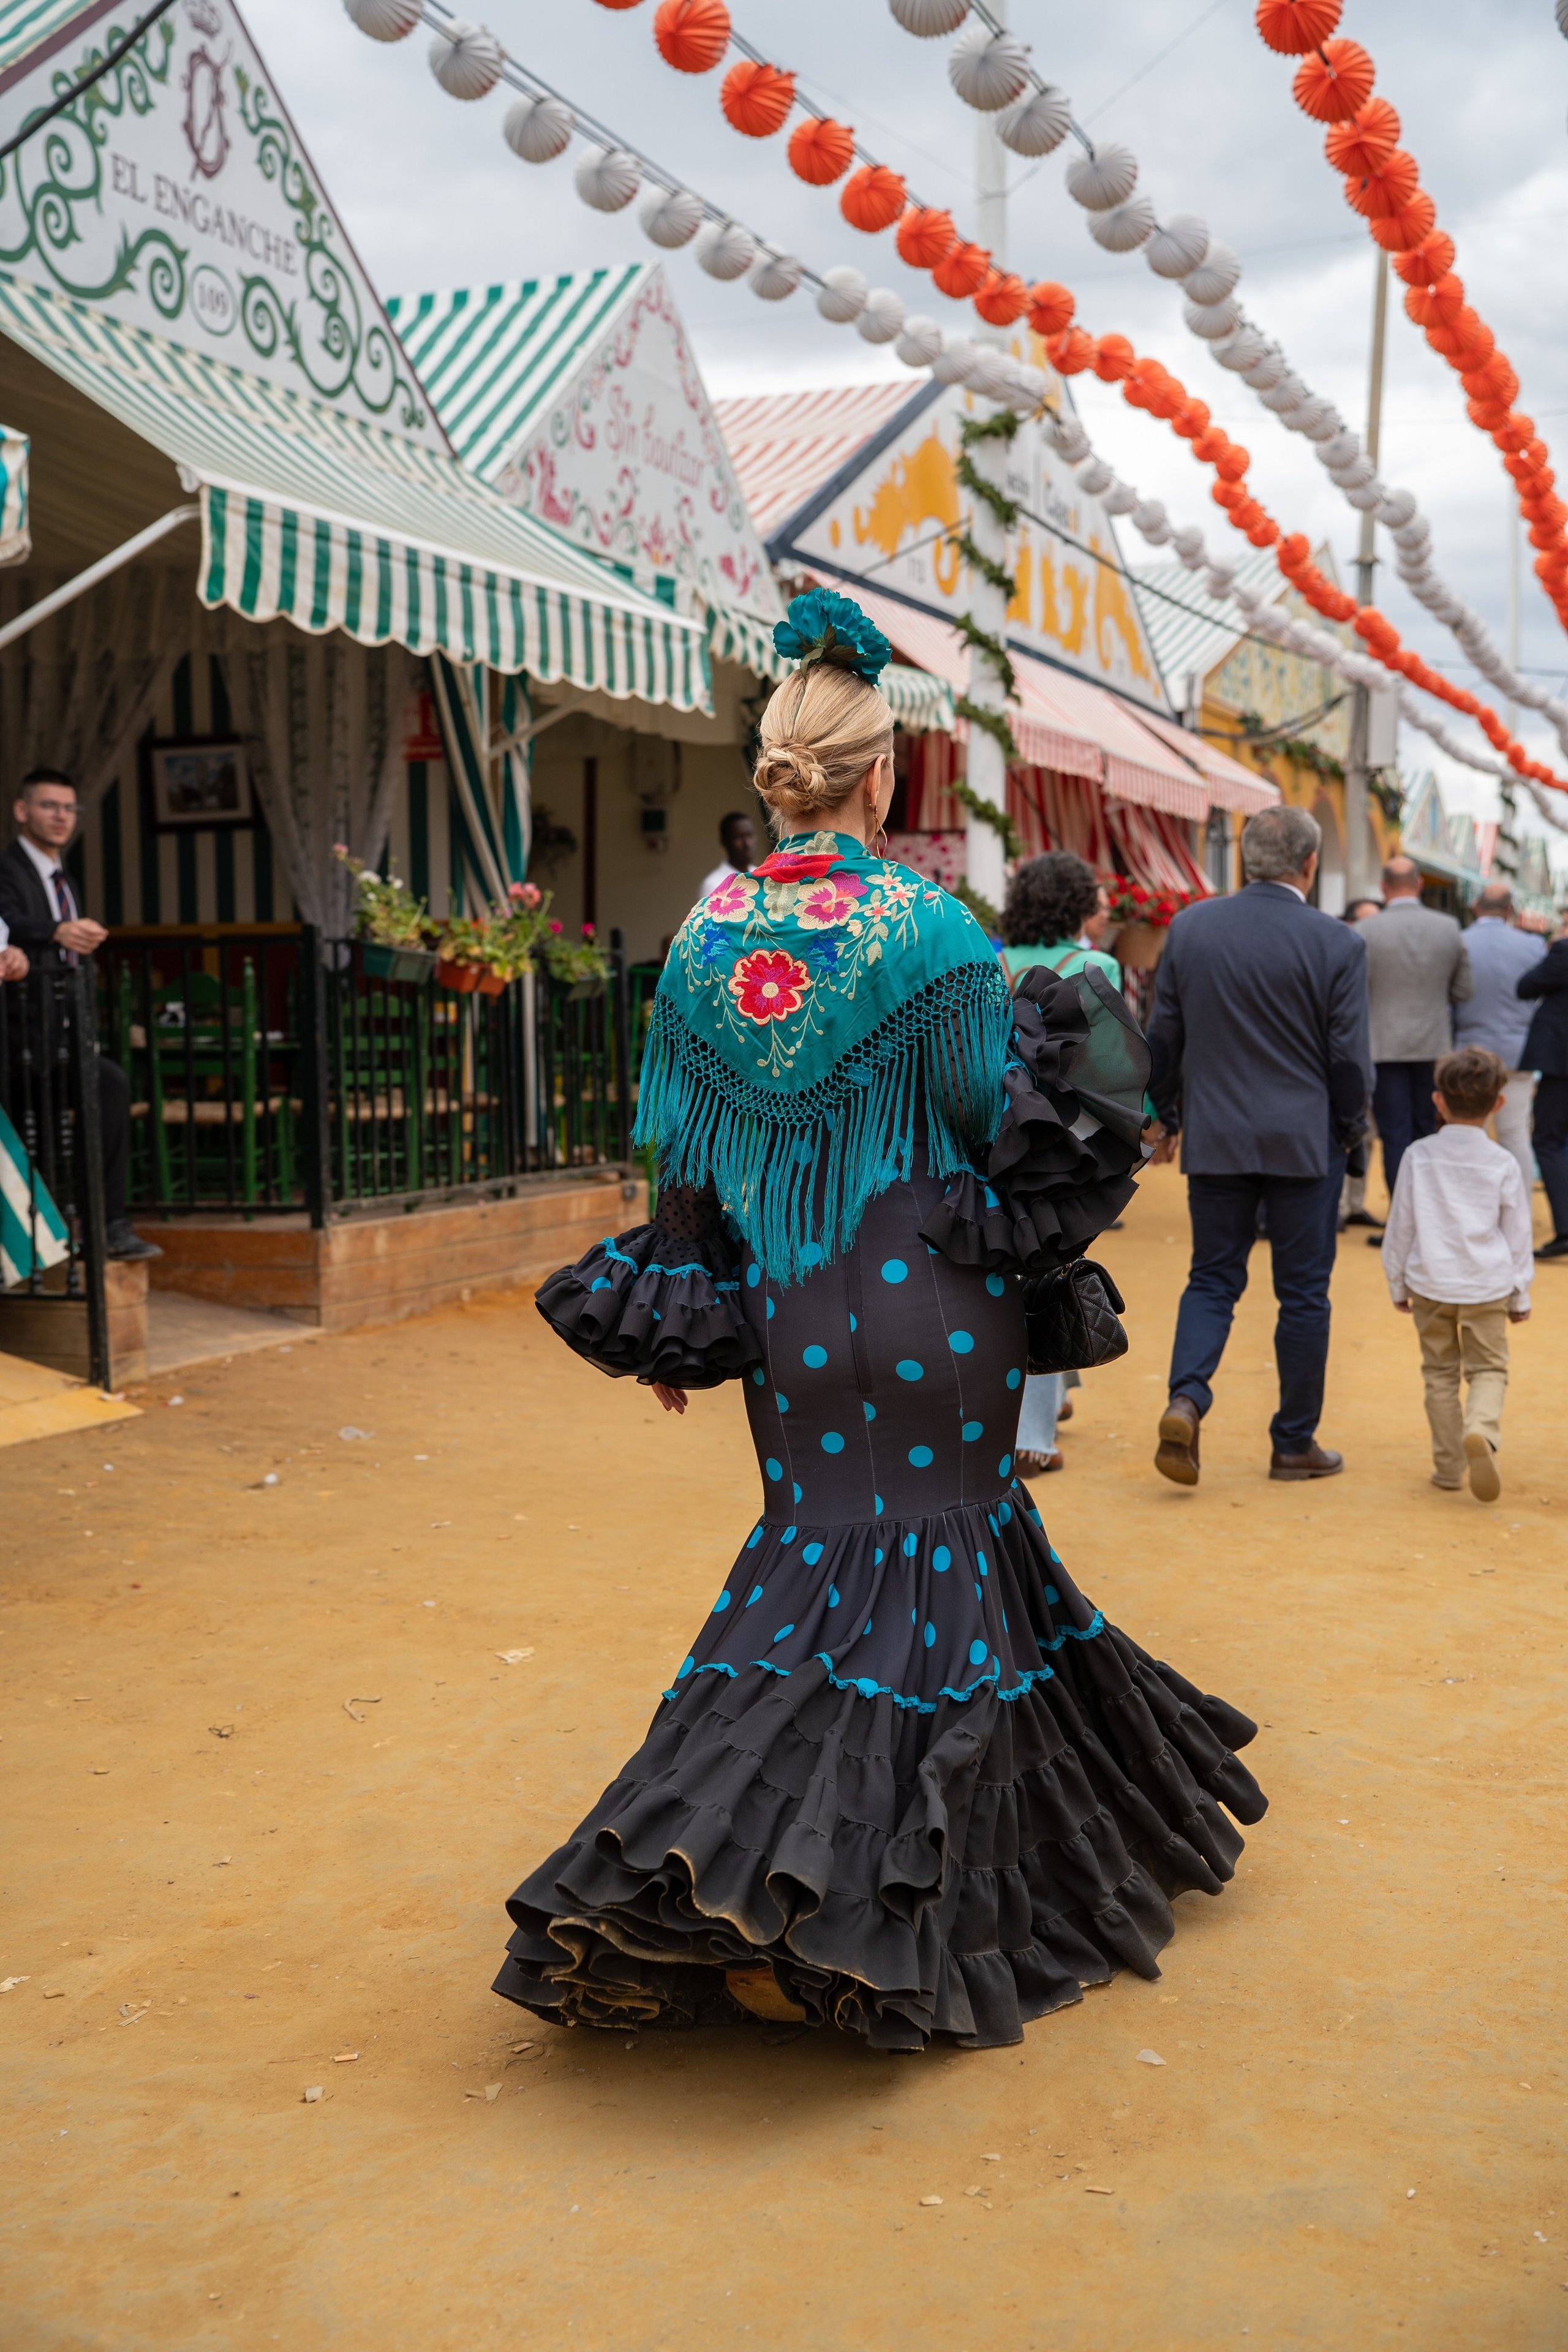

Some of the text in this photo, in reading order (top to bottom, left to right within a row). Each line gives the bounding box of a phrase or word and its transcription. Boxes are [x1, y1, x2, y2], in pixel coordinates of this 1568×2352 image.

[112, 153, 297, 276] EL ENGANCHE
[198, 283, 228, 317] 109
